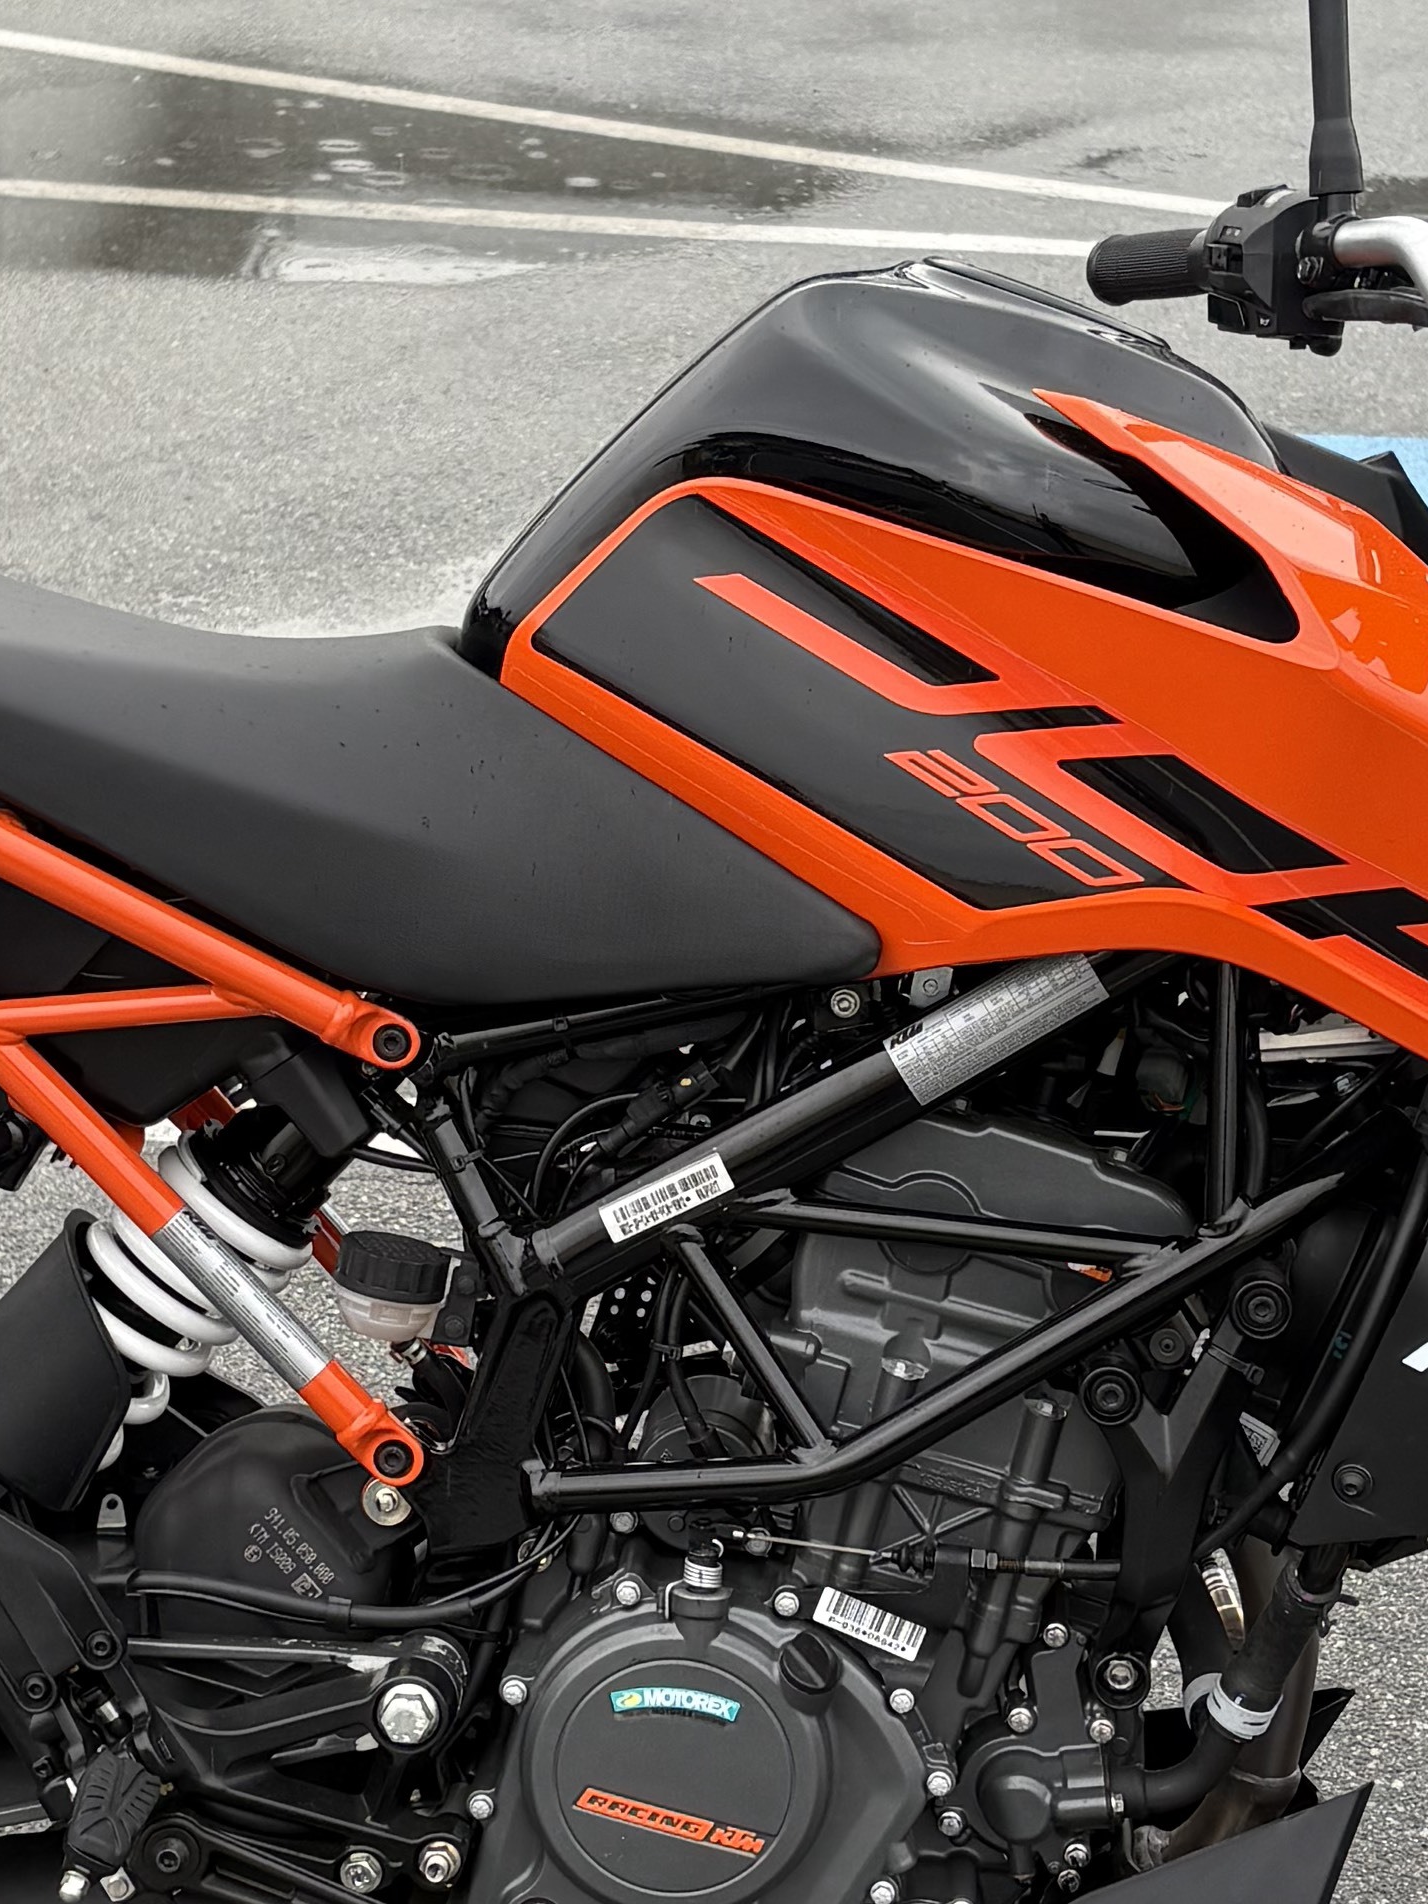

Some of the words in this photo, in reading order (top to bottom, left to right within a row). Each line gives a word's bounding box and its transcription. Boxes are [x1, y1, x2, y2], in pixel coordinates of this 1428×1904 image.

[644, 1689, 731, 1719] MOTOREX
[587, 1794, 701, 1834] RACING
[709, 1806, 766, 1855] KTM
